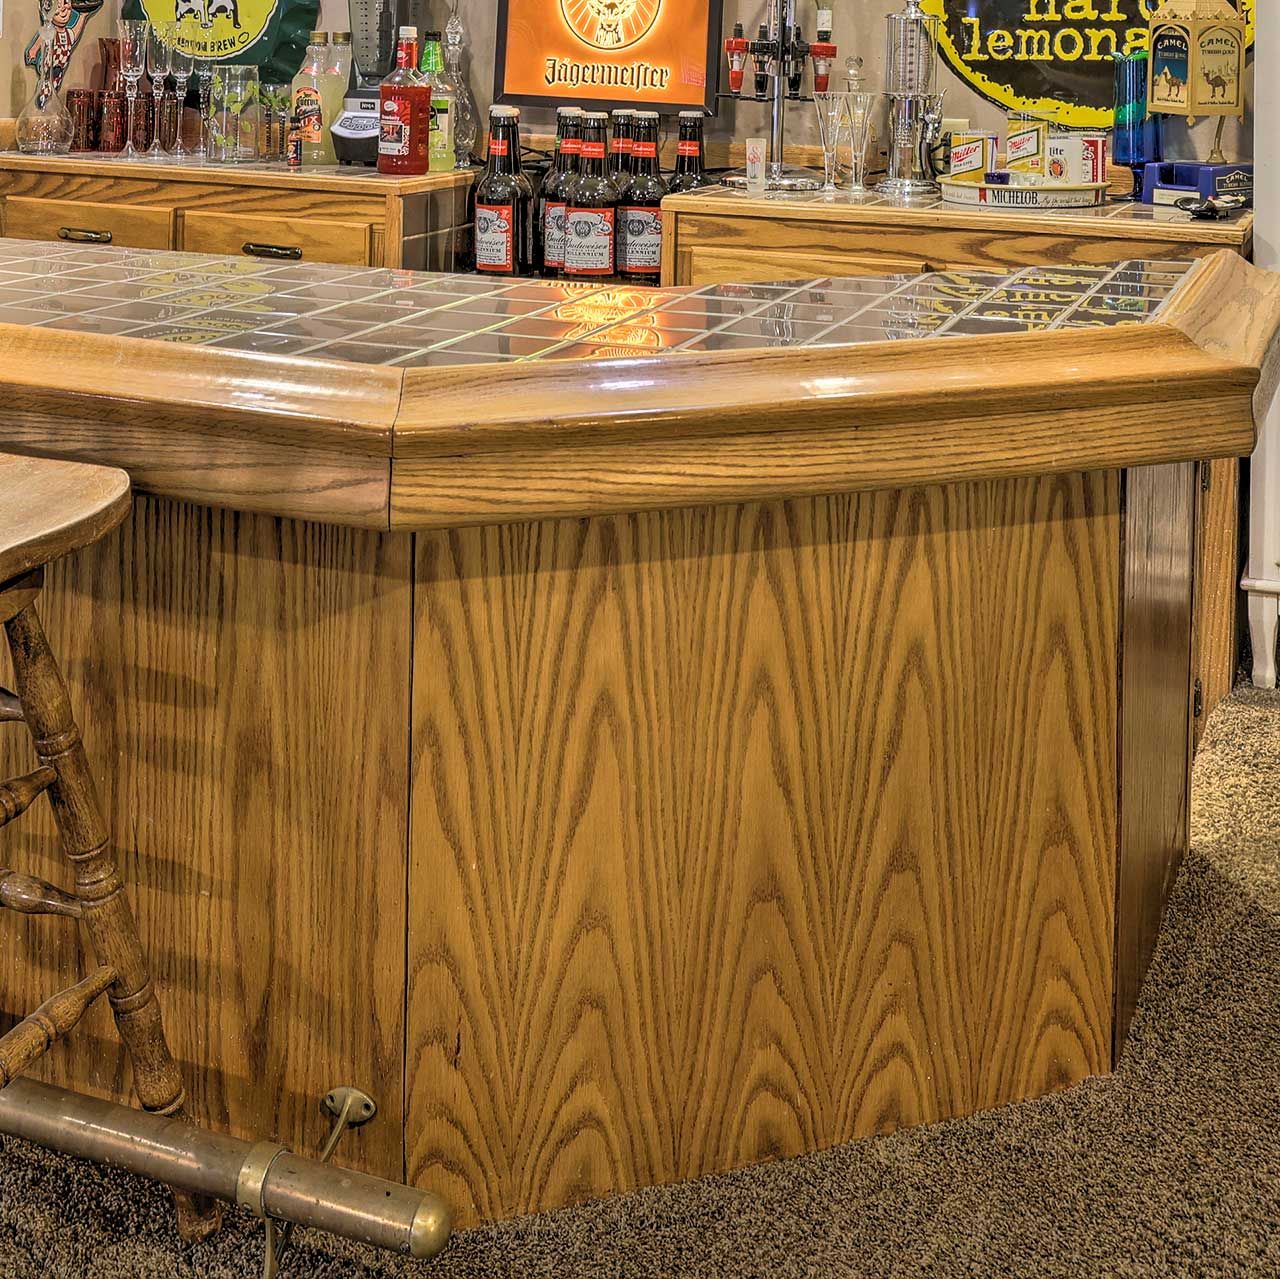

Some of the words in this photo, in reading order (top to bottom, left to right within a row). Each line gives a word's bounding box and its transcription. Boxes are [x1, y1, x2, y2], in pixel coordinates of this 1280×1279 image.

[962, 17, 1150, 61] lemona
[1157, 38, 1187, 50] CAMEL
[1200, 37, 1236, 49] CAMEL
[951, 145, 980, 161] Miller
[1225, 174, 1249, 184] CAMEL
